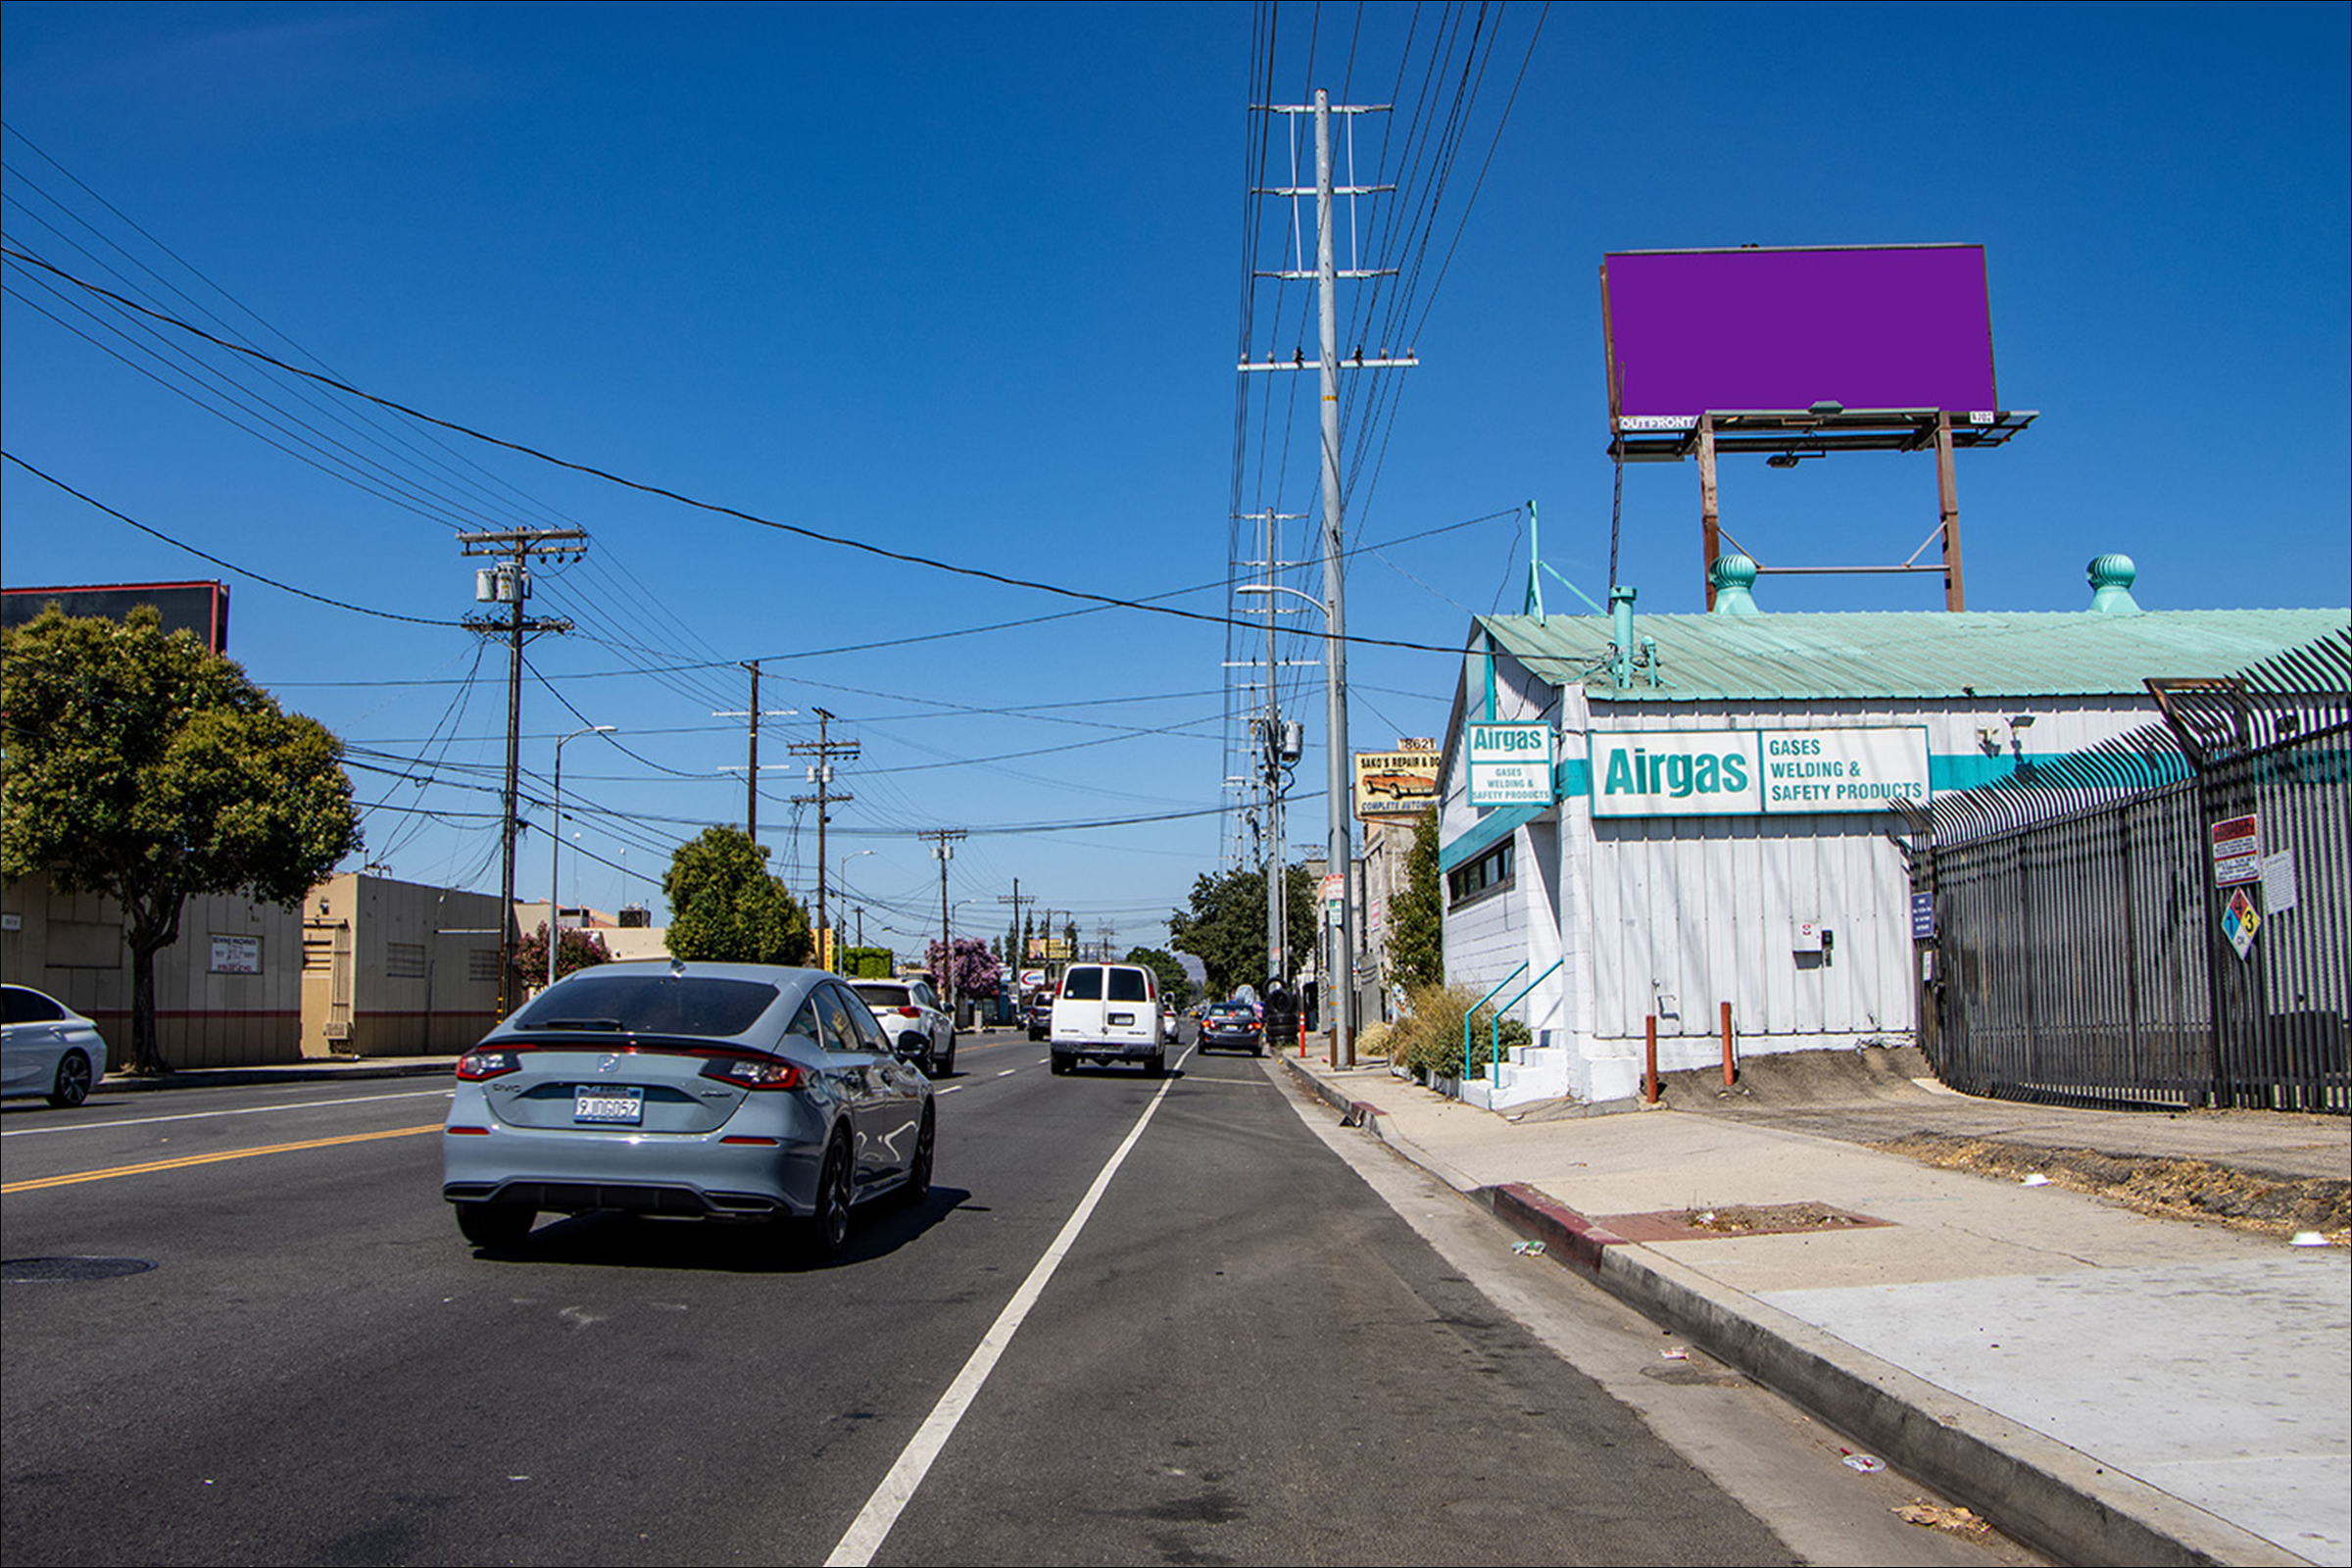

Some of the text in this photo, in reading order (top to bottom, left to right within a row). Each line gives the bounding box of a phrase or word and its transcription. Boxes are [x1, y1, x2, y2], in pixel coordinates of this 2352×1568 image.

[1622, 416, 1694, 428] OUTFRONT
[1404, 738, 1434, 750] 8621
[1474, 727, 1542, 752] Airgas
[1770, 739, 1821, 756] GASES
[1361, 758, 1390, 768] SAKO'S
[1393, 757, 1419, 767] REPAIR
[1423, 757, 1427, 767] &
[1771, 760, 1861, 778] WELDING &
[1495, 767, 1522, 777] GASES
[1604, 748, 1748, 798] Airgas
[1488, 779, 1534, 788] WELDING &
[1473, 790, 1549, 800] SAFETY PRODUCTS
[1773, 782, 1922, 801] SAFETY PRODUCTS
[1361, 801, 1398, 810] COMPLETE
[2234, 893, 2243, 915] 4
[2227, 910, 2254, 935] 1 3
